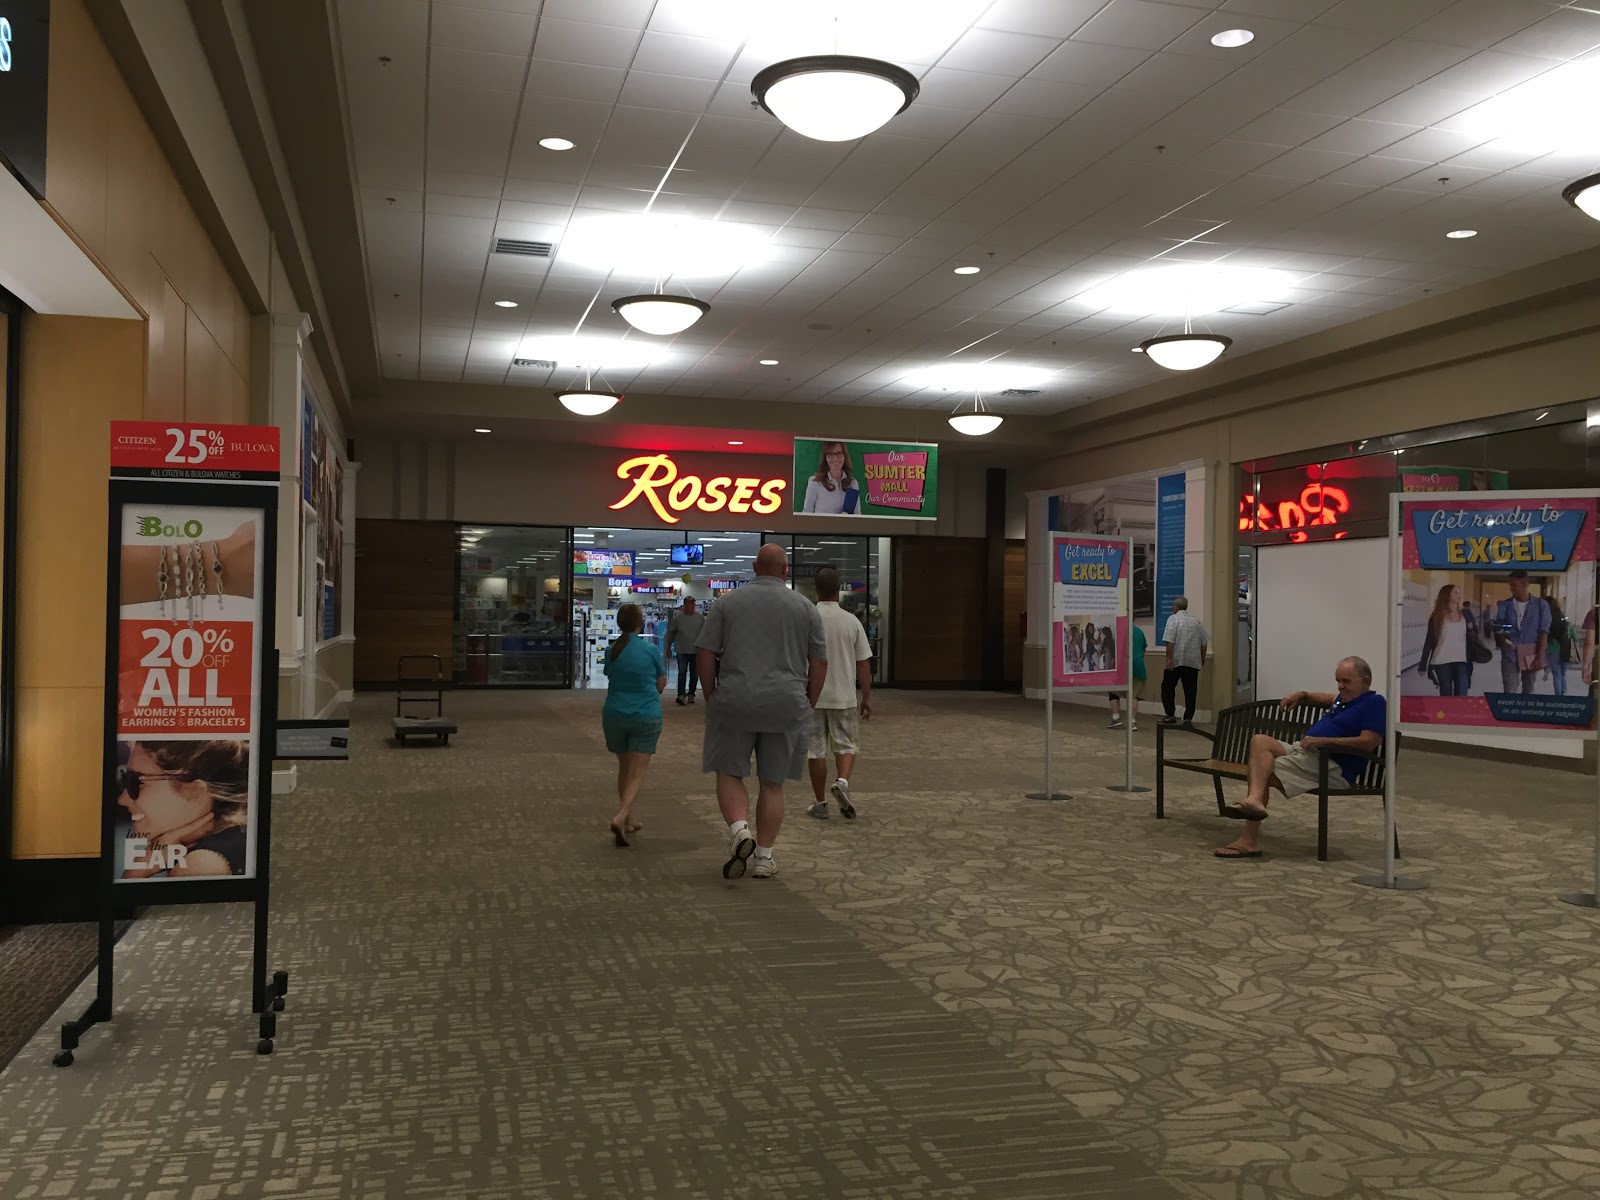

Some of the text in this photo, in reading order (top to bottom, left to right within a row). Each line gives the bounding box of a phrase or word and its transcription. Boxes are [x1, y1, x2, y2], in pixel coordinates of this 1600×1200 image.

[118, 436, 156, 445] CITIZEN
[209, 446, 224, 456] OFF
[231, 442, 275, 453] BULOVA
[888, 451, 906, 463] Our
[151, 469, 161, 477] ALL
[162, 469, 184, 477] CITIZEN
[191, 470, 213, 478] BULOVA
[214, 471, 241, 479] WATCHES
[864, 464, 926, 481] SUMTER
[880, 481, 910, 492] MALL
[865, 492, 926, 507] Our Community
[1429, 503, 1565, 534] Get ready to
[1064, 544, 1116, 562] Get ready to
[1447, 534, 1555, 565] EXCEL
[1071, 562, 1112, 581] EXCEL
[608, 577, 633, 587] Boys
[710, 580, 729, 589] Infant
[729, 581, 735, 589] &
[202, 654, 230, 668] OFF
[137, 668, 233, 706] ALL
[1546, 702, 1586, 711] outstanding
[133, 708, 235, 717] WOMEN'S FASHION
[1521, 709, 1545, 717] activity
[122, 717, 246, 727] EARRINGS & BRACELETS
[125, 829, 151, 839] love
[149, 840, 168, 851] the
[123, 838, 188, 870] EAR
